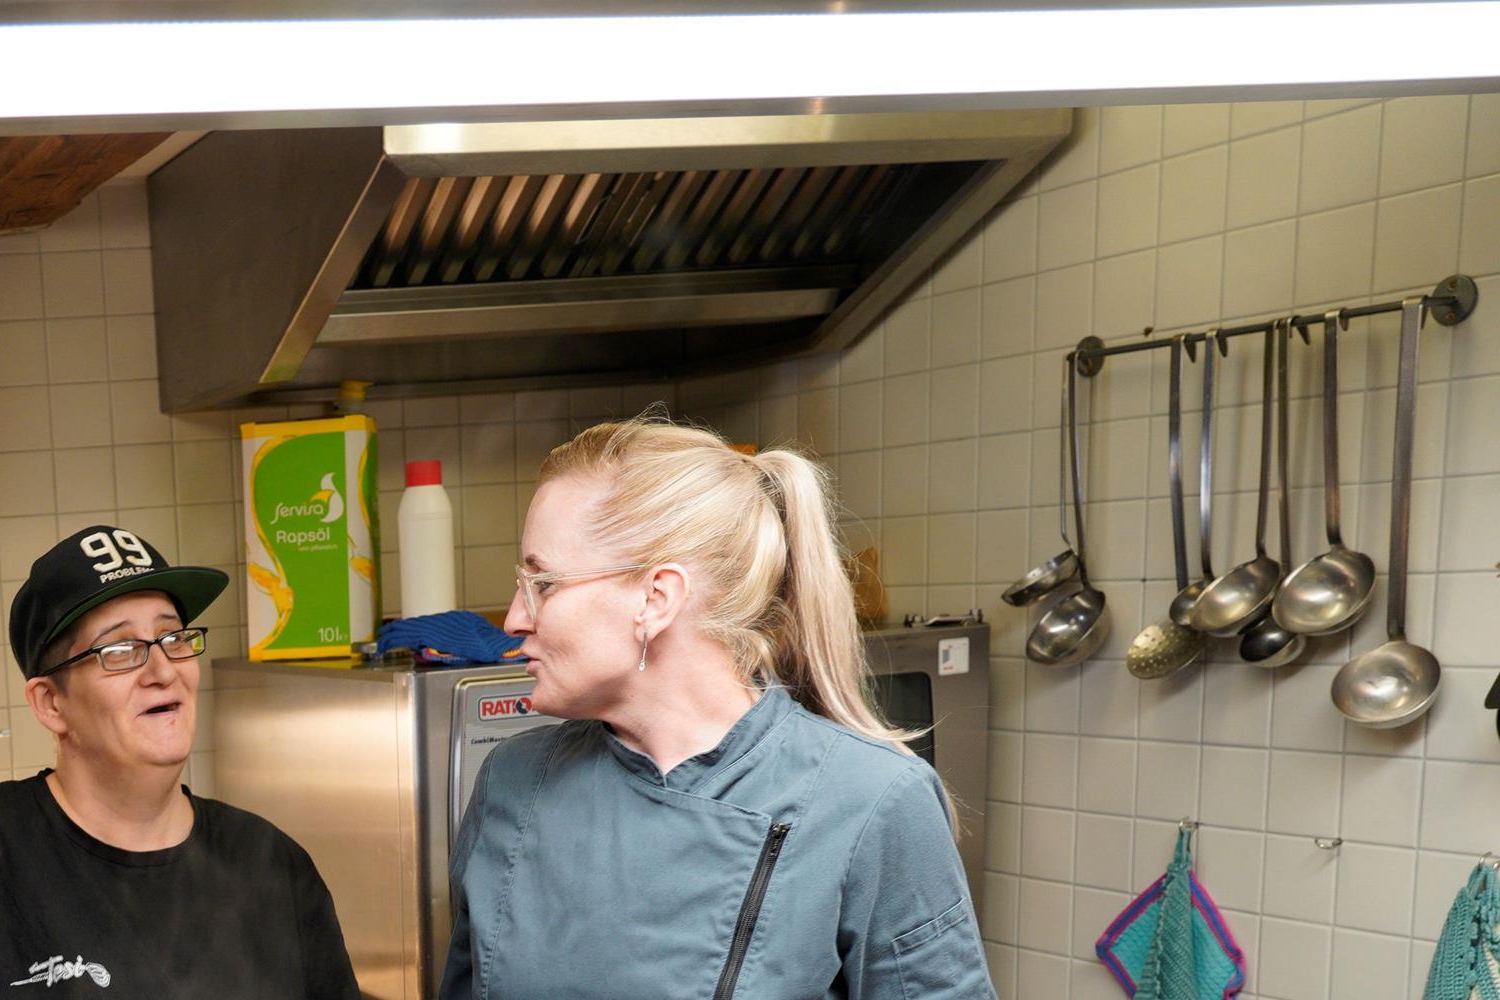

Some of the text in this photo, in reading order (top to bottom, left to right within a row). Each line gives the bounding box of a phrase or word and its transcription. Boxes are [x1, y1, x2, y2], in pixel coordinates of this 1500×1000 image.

[275, 526, 331, 546] Rapsöl
[79, 529, 154, 573] 99
[481, 697, 536, 717] RATIO
